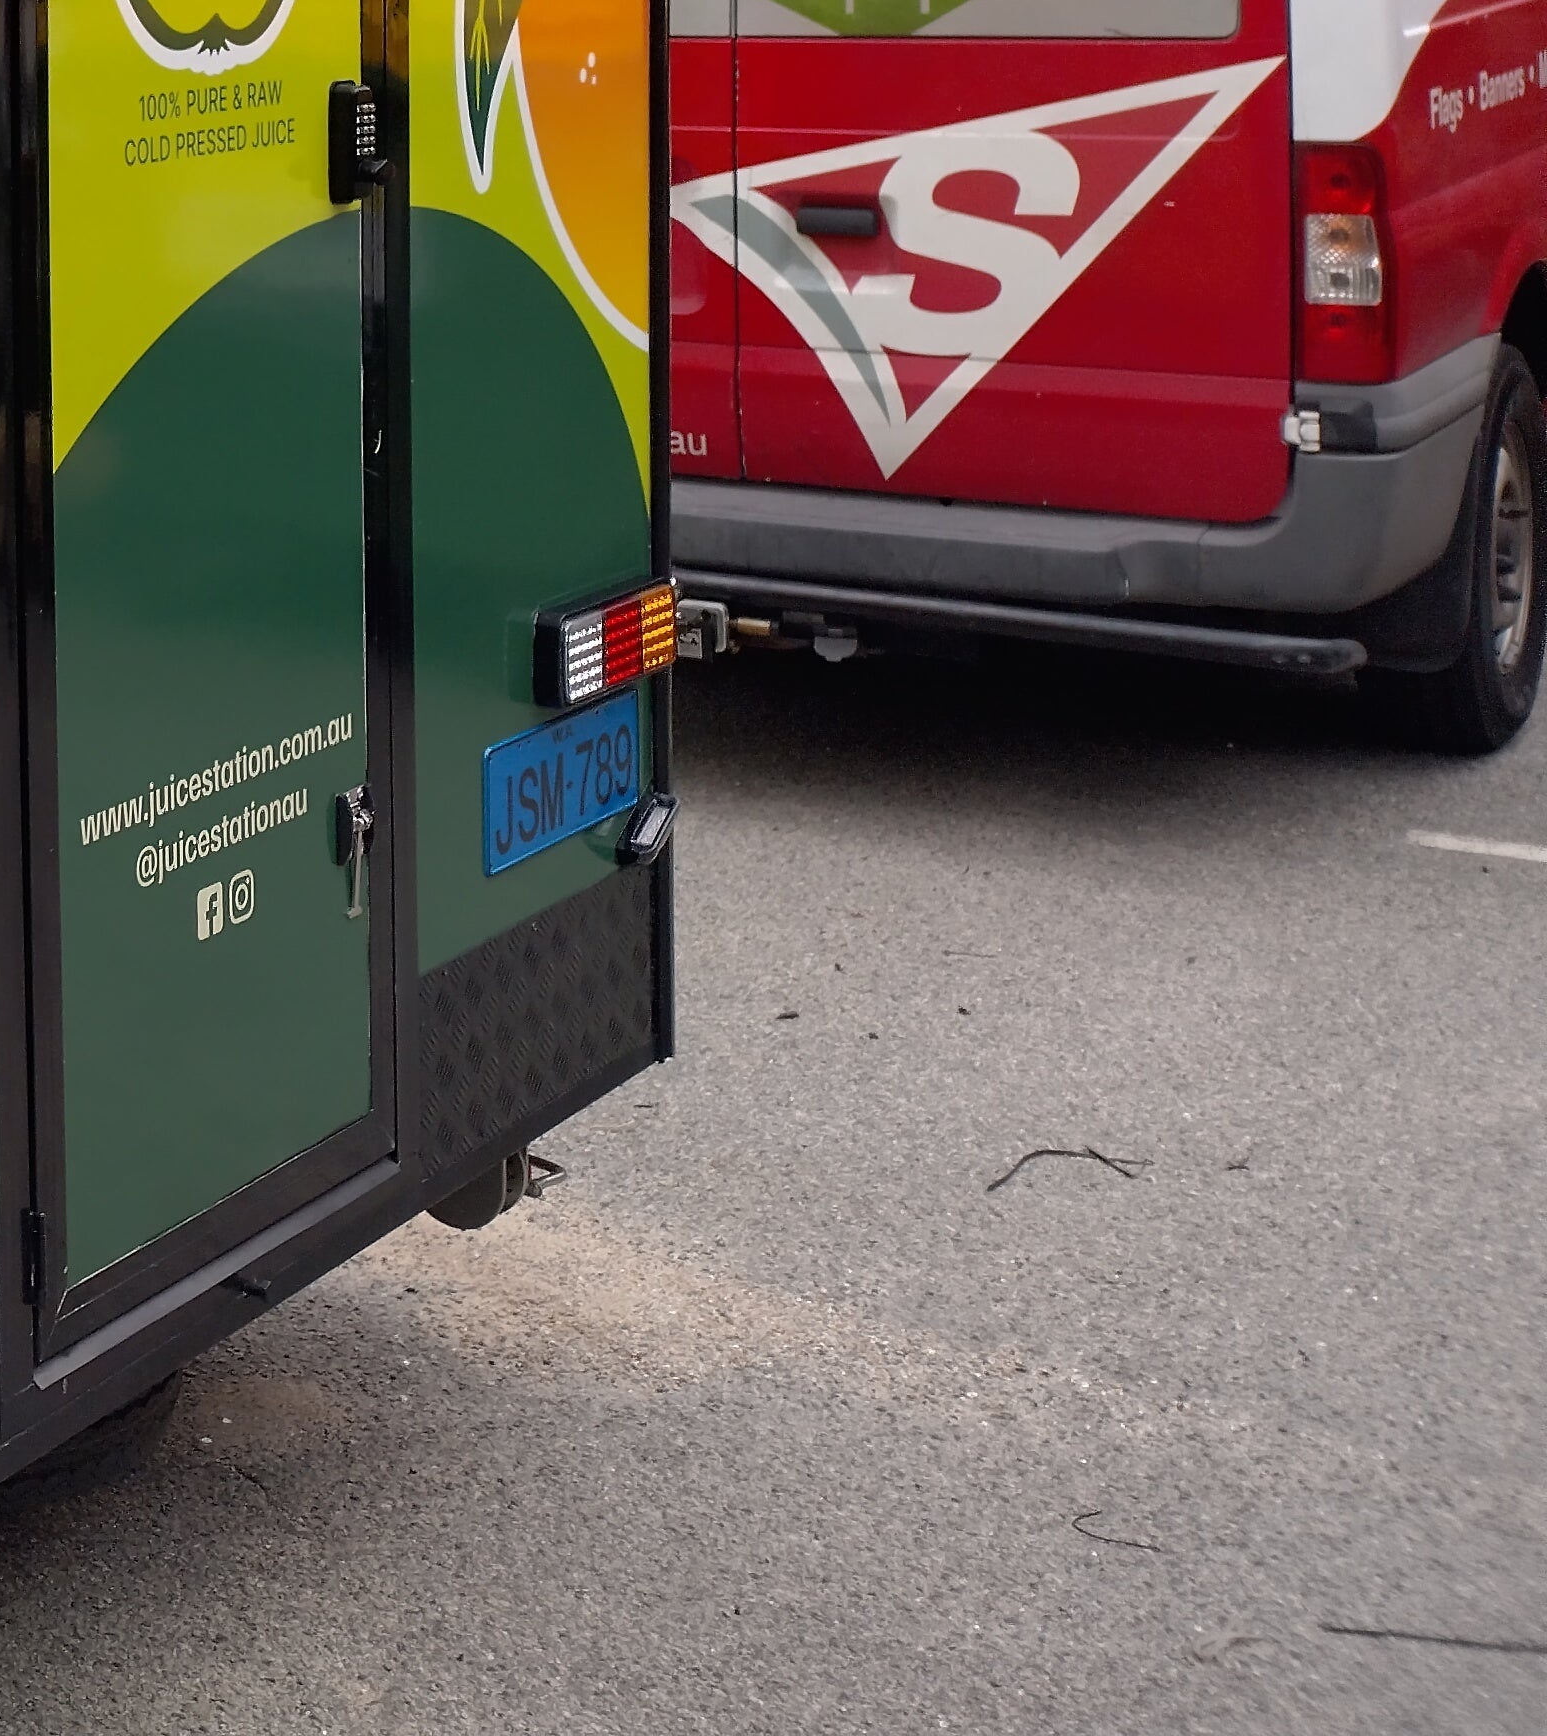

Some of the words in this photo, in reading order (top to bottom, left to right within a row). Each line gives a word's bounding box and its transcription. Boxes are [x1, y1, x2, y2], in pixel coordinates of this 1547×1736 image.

[138, 89, 182, 122] 100%
[186, 85, 227, 117] PURE
[232, 84, 243, 110] &
[247, 80, 283, 109] RAW
[1430, 85, 1464, 134] Flags
[1479, 65, 1526, 112] Banners
[124, 134, 171, 167] COLD
[175, 123, 248, 160] PRESSED
[251, 118, 296, 150] JUICE
[80, 712, 353, 846] www.juicestation.com.au
[136, 787, 309, 887] @juicestationau
